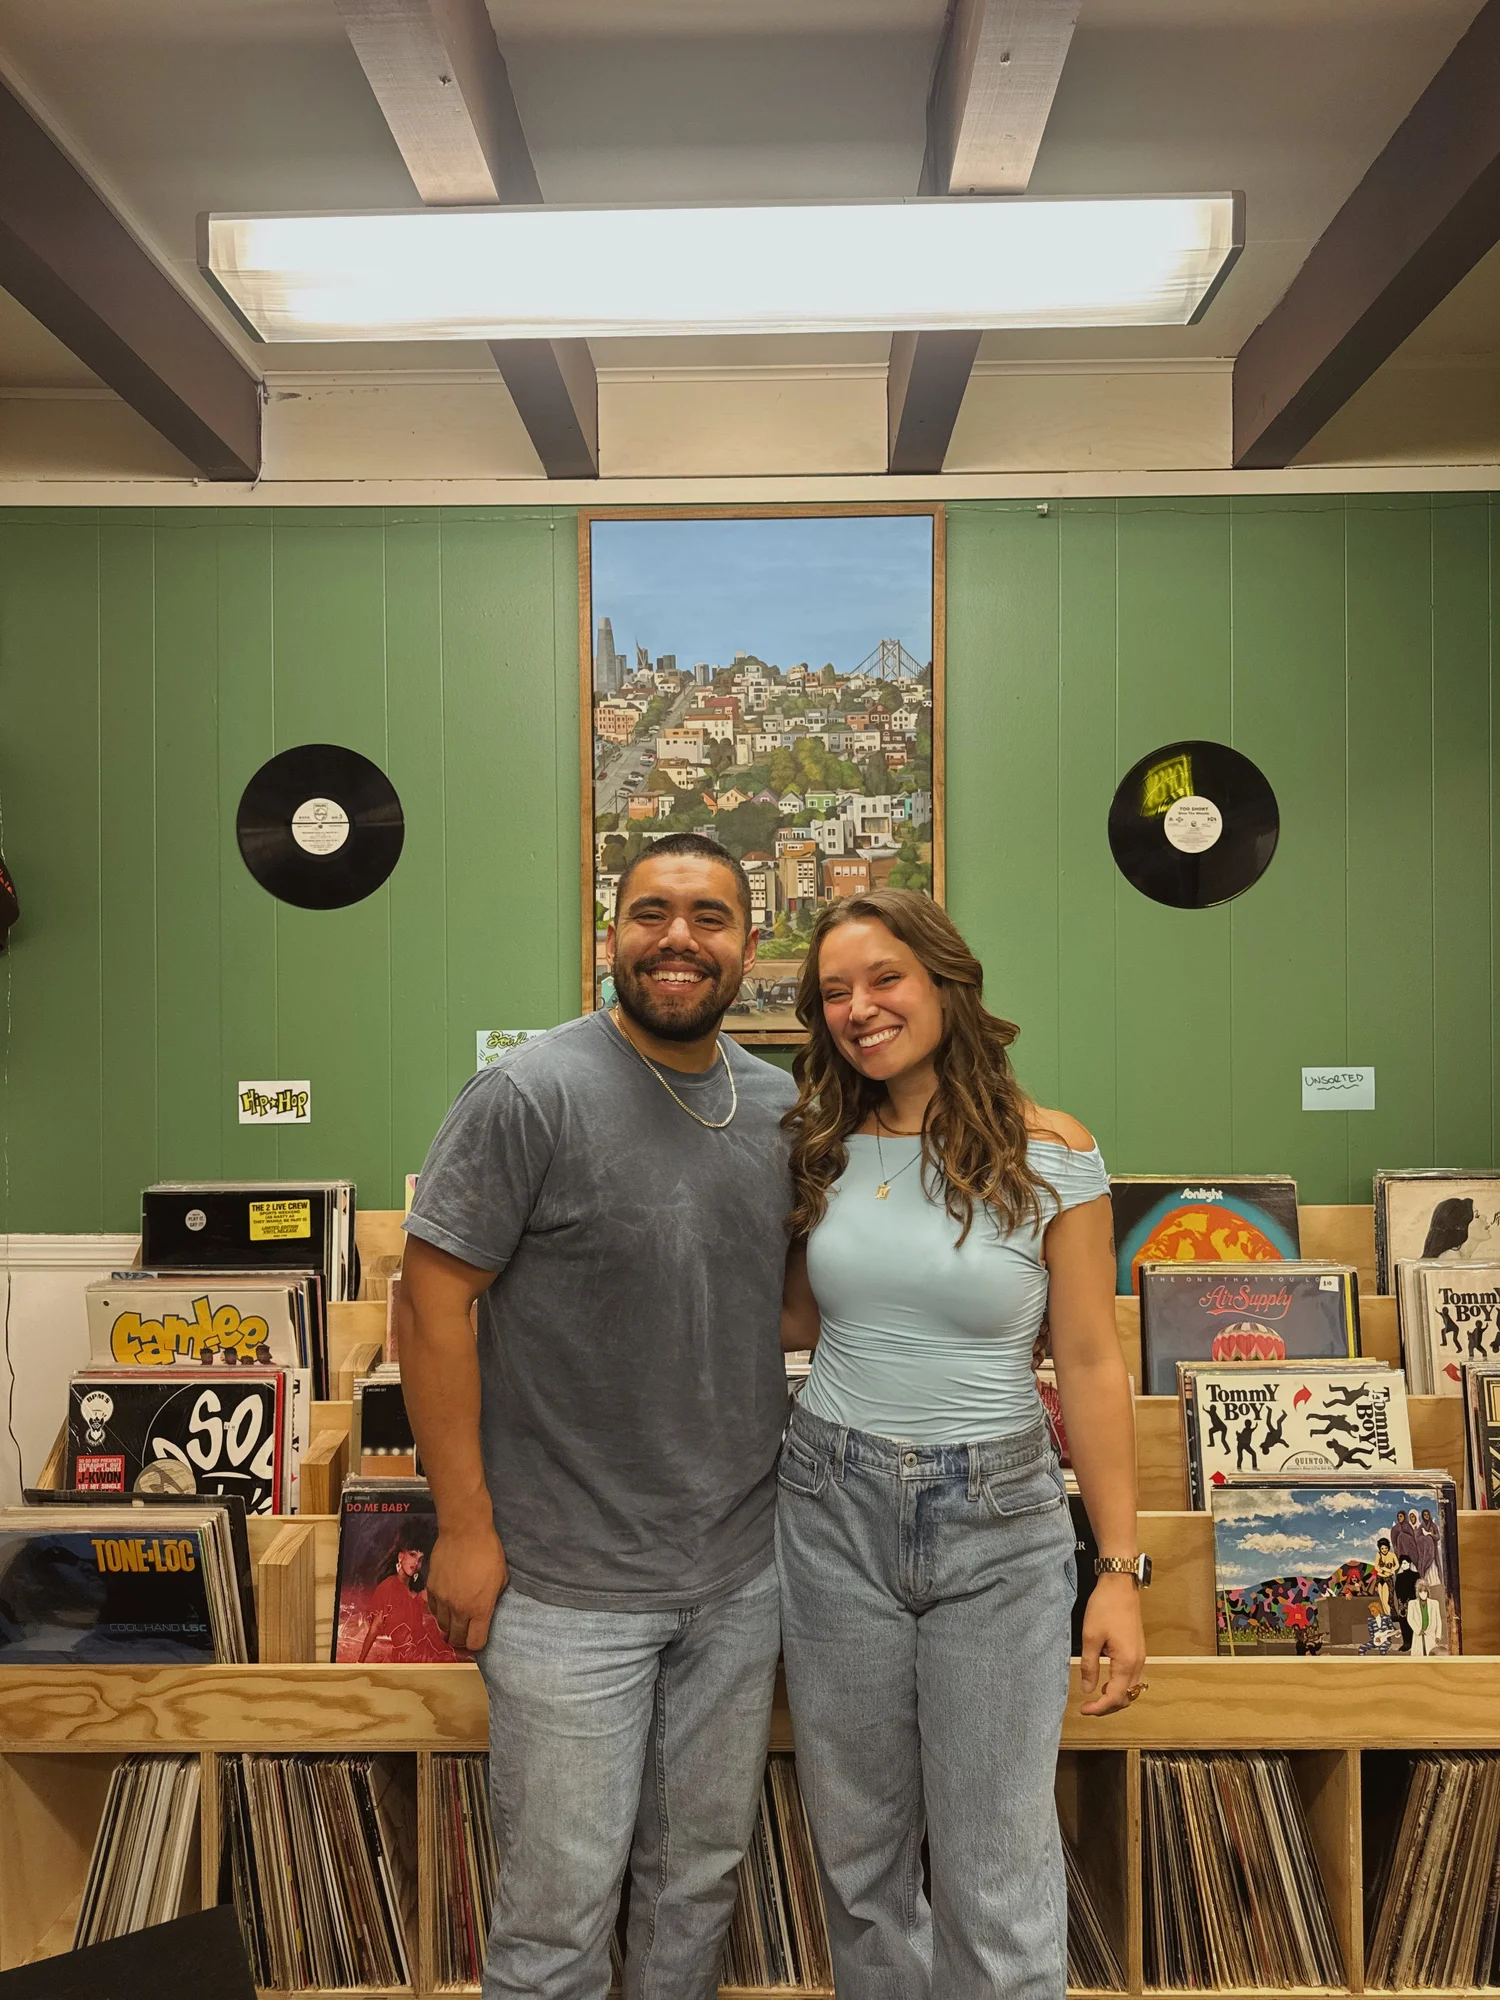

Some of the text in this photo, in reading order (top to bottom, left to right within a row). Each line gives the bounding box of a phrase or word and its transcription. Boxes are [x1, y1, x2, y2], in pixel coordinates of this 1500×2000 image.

[486, 1030, 527, 1048] Soul
[1304, 1073, 1364, 1086] UNSORTED
[1180, 1187, 1224, 1202] Sonlight
[252, 1204, 264, 1212] THE
[272, 1203, 286, 1211] LIVE
[288, 1201, 308, 1210] CREW
[1199, 1284, 1294, 1316] Air Supply
[87, 1393, 110, 1404] BPM'S
[1295, 1457, 1329, 1466] QUINTON
[78, 1471, 122, 1484] J-KWON
[346, 1503, 410, 1512] DO ME BABY
[109, 1624, 143, 1632] COOL
[144, 1624, 180, 1632] HAND
